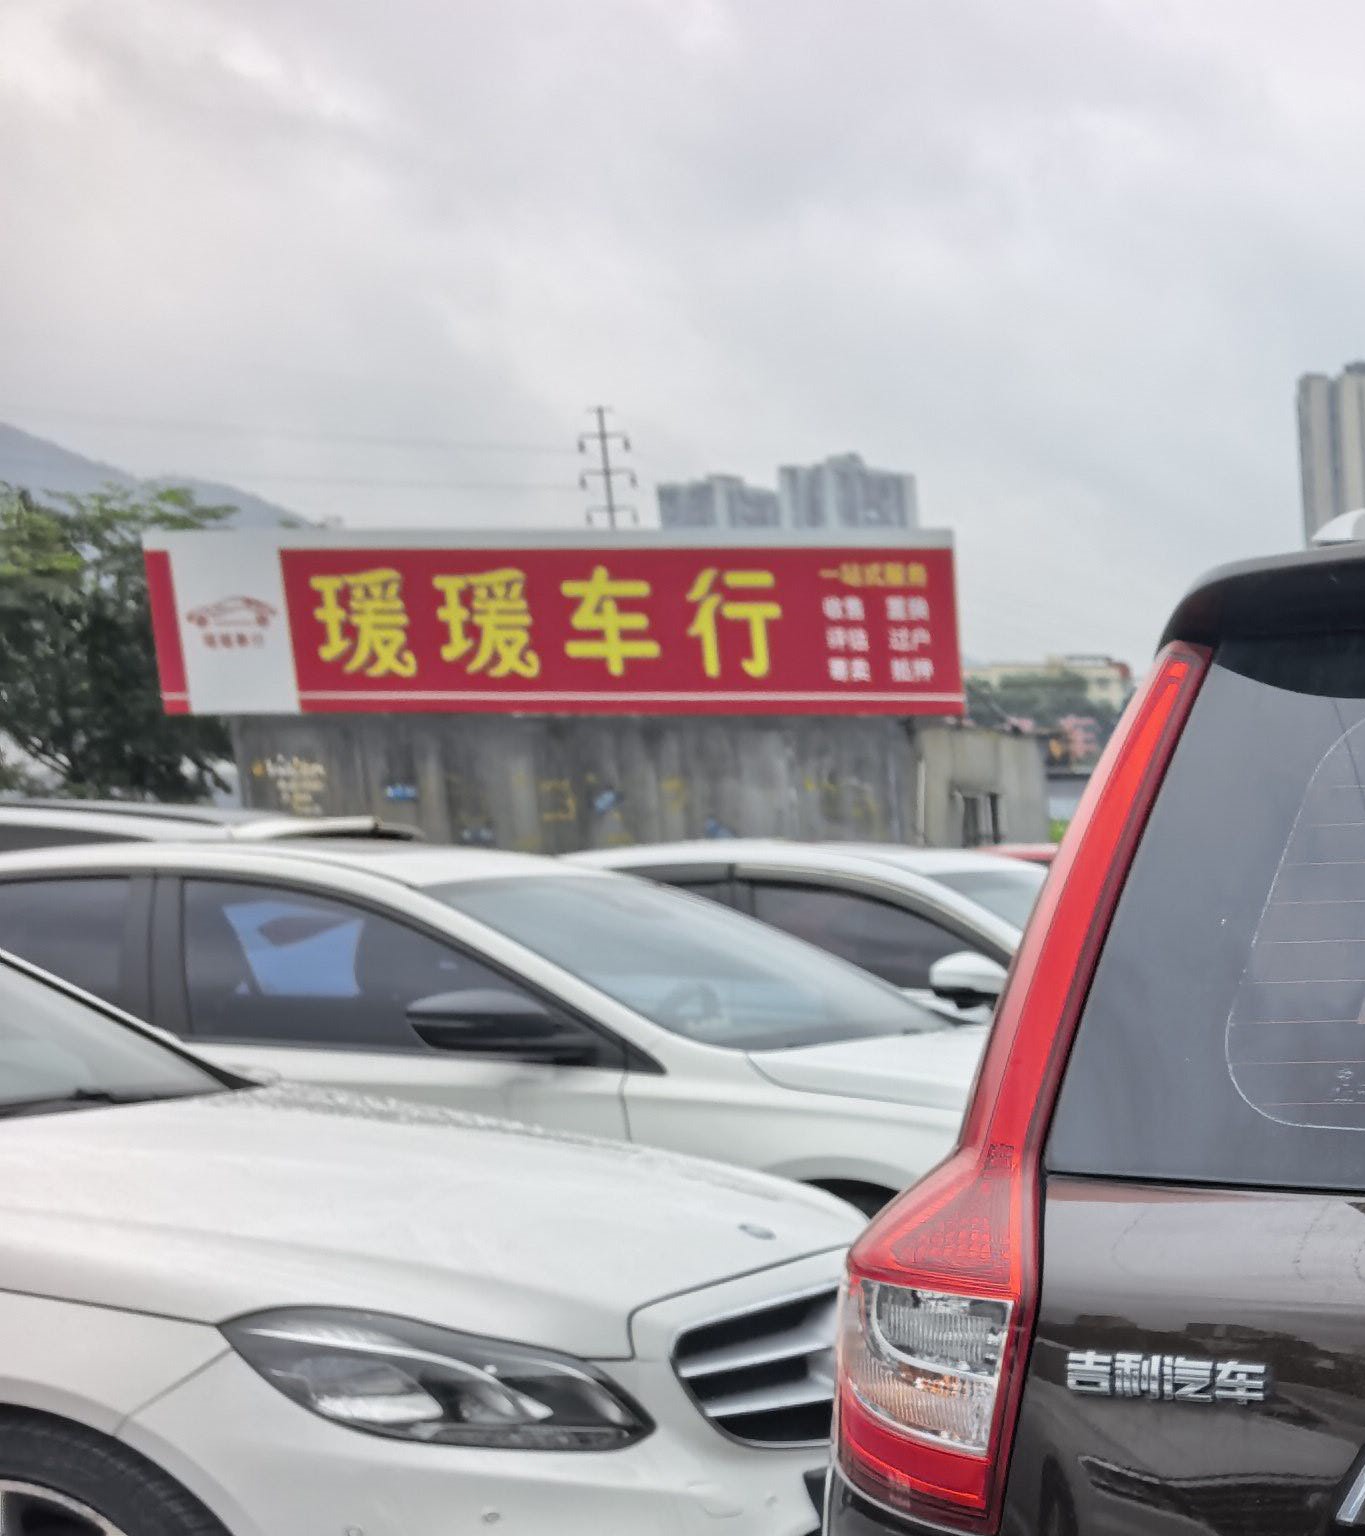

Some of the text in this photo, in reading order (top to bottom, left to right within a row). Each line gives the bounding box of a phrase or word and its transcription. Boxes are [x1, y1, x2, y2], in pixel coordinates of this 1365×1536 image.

[308, 565, 783, 678] 瑗瑗车行
[1067, 1351, 1266, 1405] 吉利汽车
